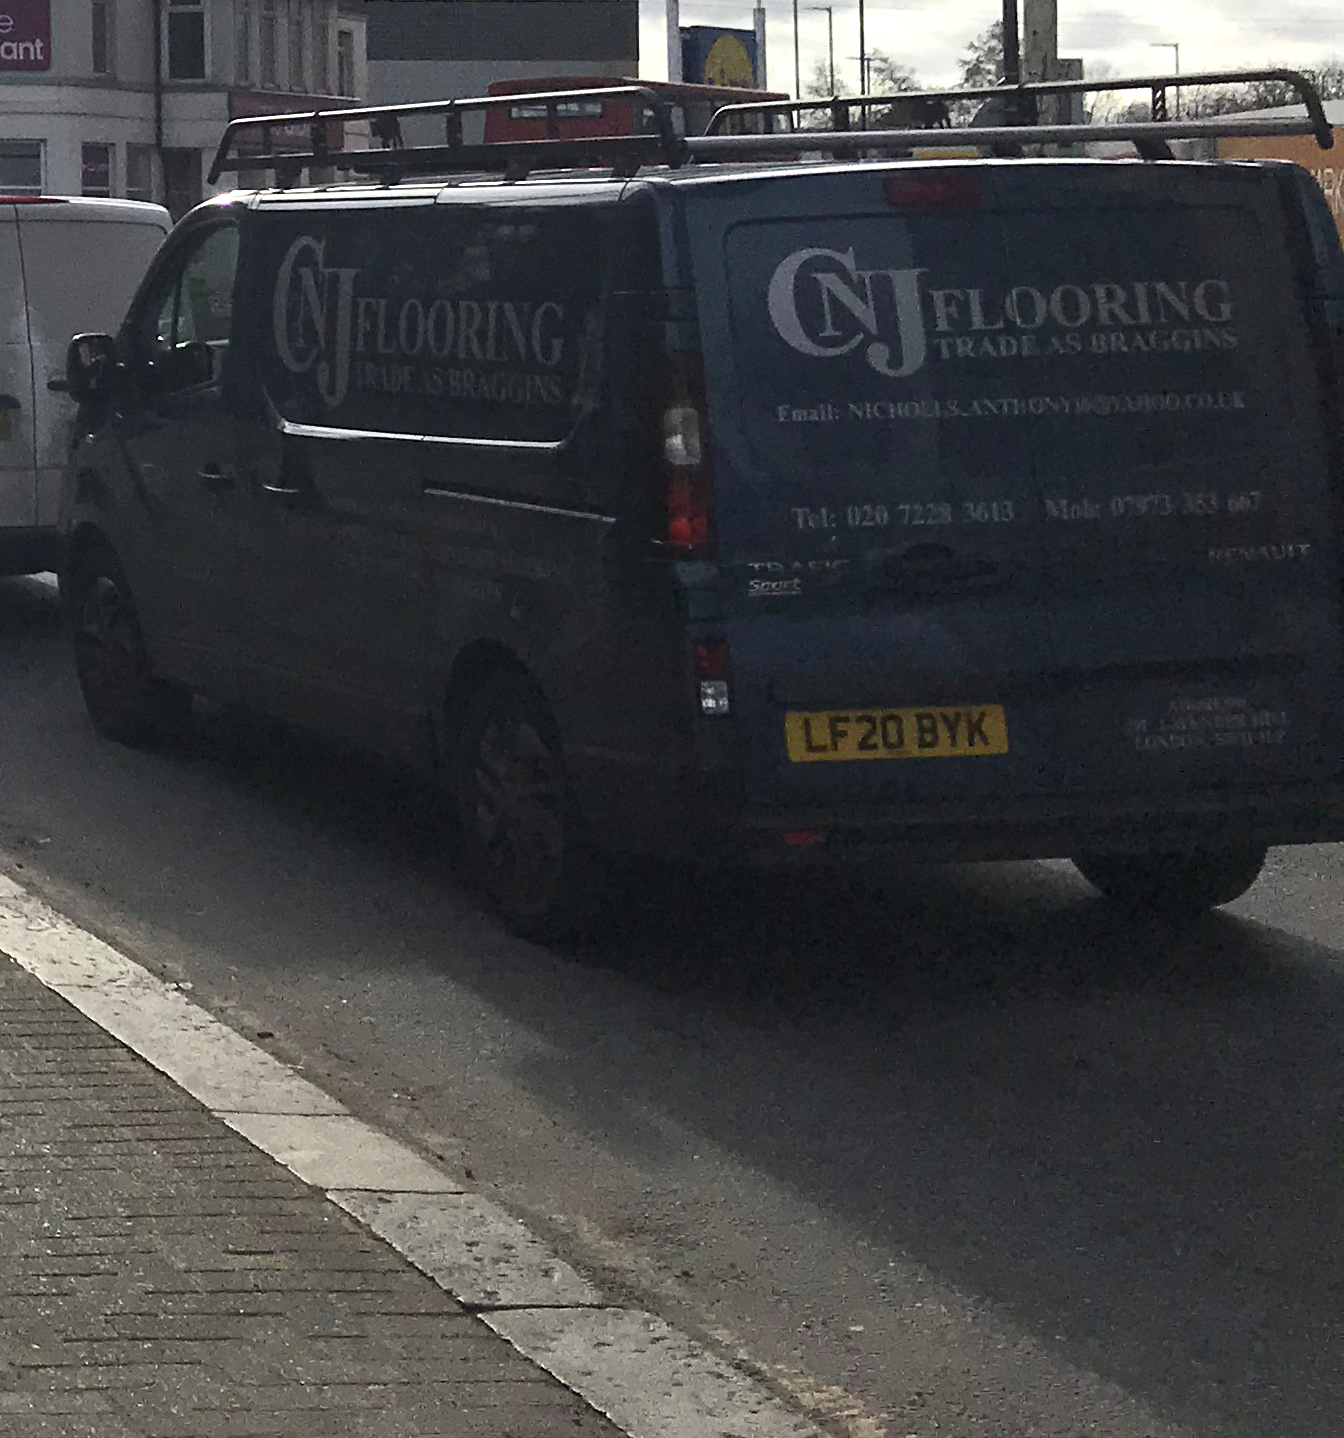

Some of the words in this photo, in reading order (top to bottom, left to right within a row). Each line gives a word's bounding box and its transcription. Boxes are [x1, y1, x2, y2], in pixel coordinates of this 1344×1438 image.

[928, 278, 1235, 333] FLOORING
[356, 297, 565, 367] FLOORING
[932, 333, 1036, 360] TRADE
[1048, 332, 1083, 356] AS
[1089, 327, 1239, 355] BRAGGINS
[357, 362, 415, 393] TRADE
[448, 365, 562, 405] BRAGGINS
[776, 403, 842, 425] Email:
[791, 505, 837, 530] Tel:
[846, 502, 889, 528] 020
[897, 501, 953, 526] 7228
[803, 713, 905, 753] LF20
[914, 711, 991, 749] BYK
